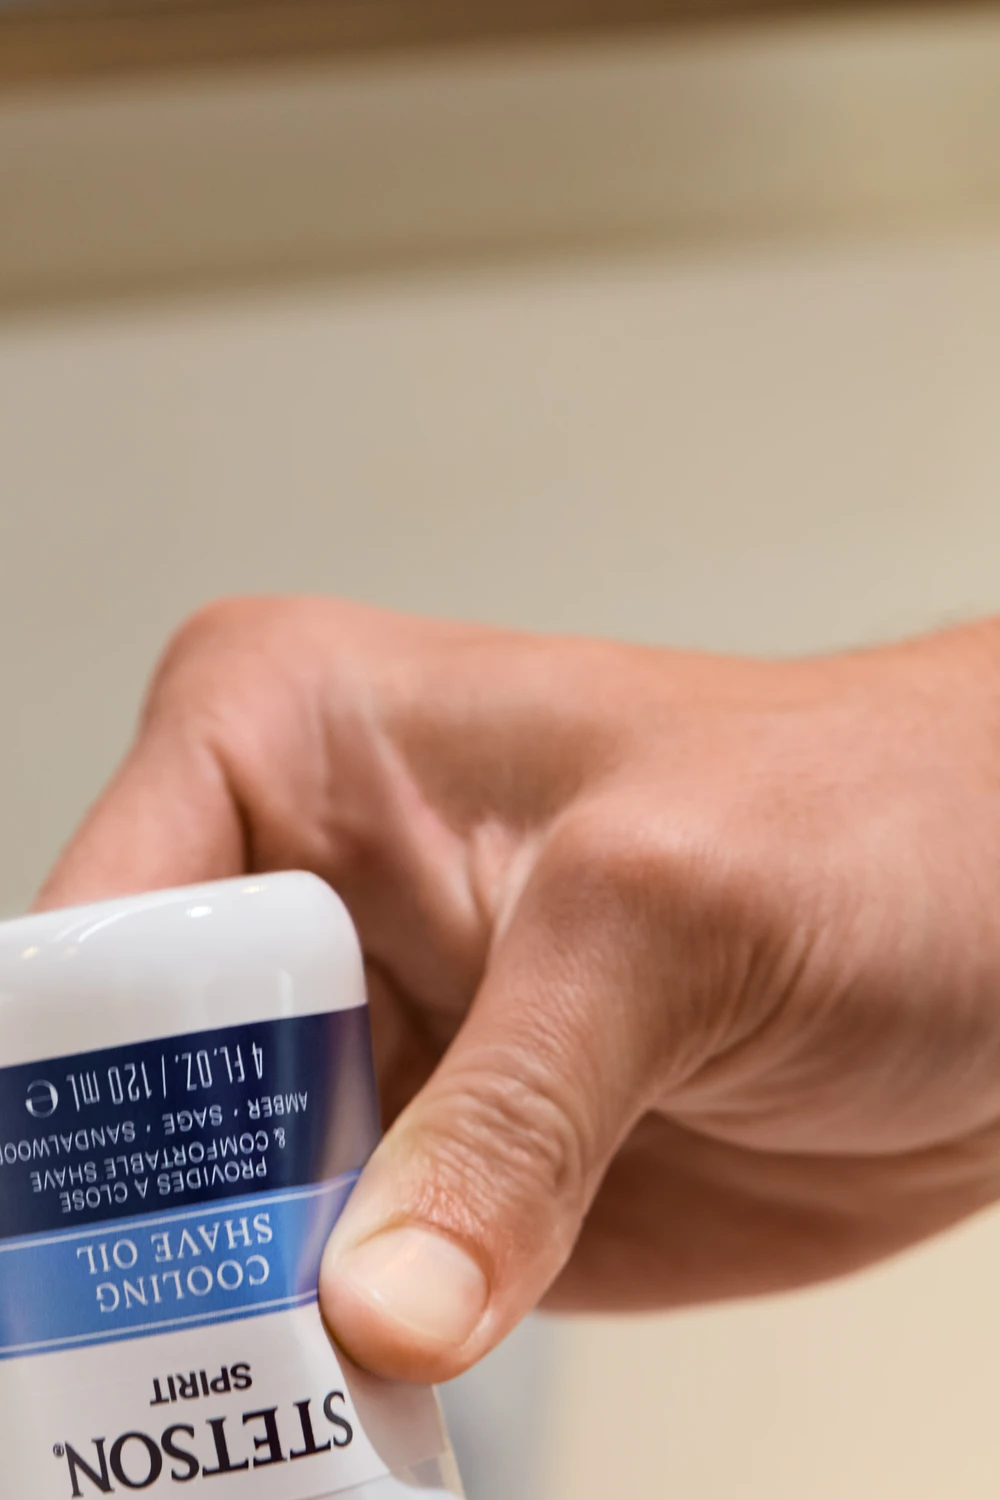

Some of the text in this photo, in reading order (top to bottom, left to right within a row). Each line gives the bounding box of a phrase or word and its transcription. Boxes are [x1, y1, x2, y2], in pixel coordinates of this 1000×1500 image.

[251, 1041, 265, 1080] 4
[107, 1061, 153, 1105] 120
[162, 1104, 224, 1136] SAGE
[248, 1091, 308, 1120] AMBER
[29, 1127, 287, 1193] & COMFORTABLE SHAVE
[59, 1155, 268, 1214] PROVIDES A CLOSE
[77, 1213, 273, 1275] SHAVE OIL
[96, 1255, 270, 1312] COOLING
[150, 1362, 253, 1406] SPIRIT
